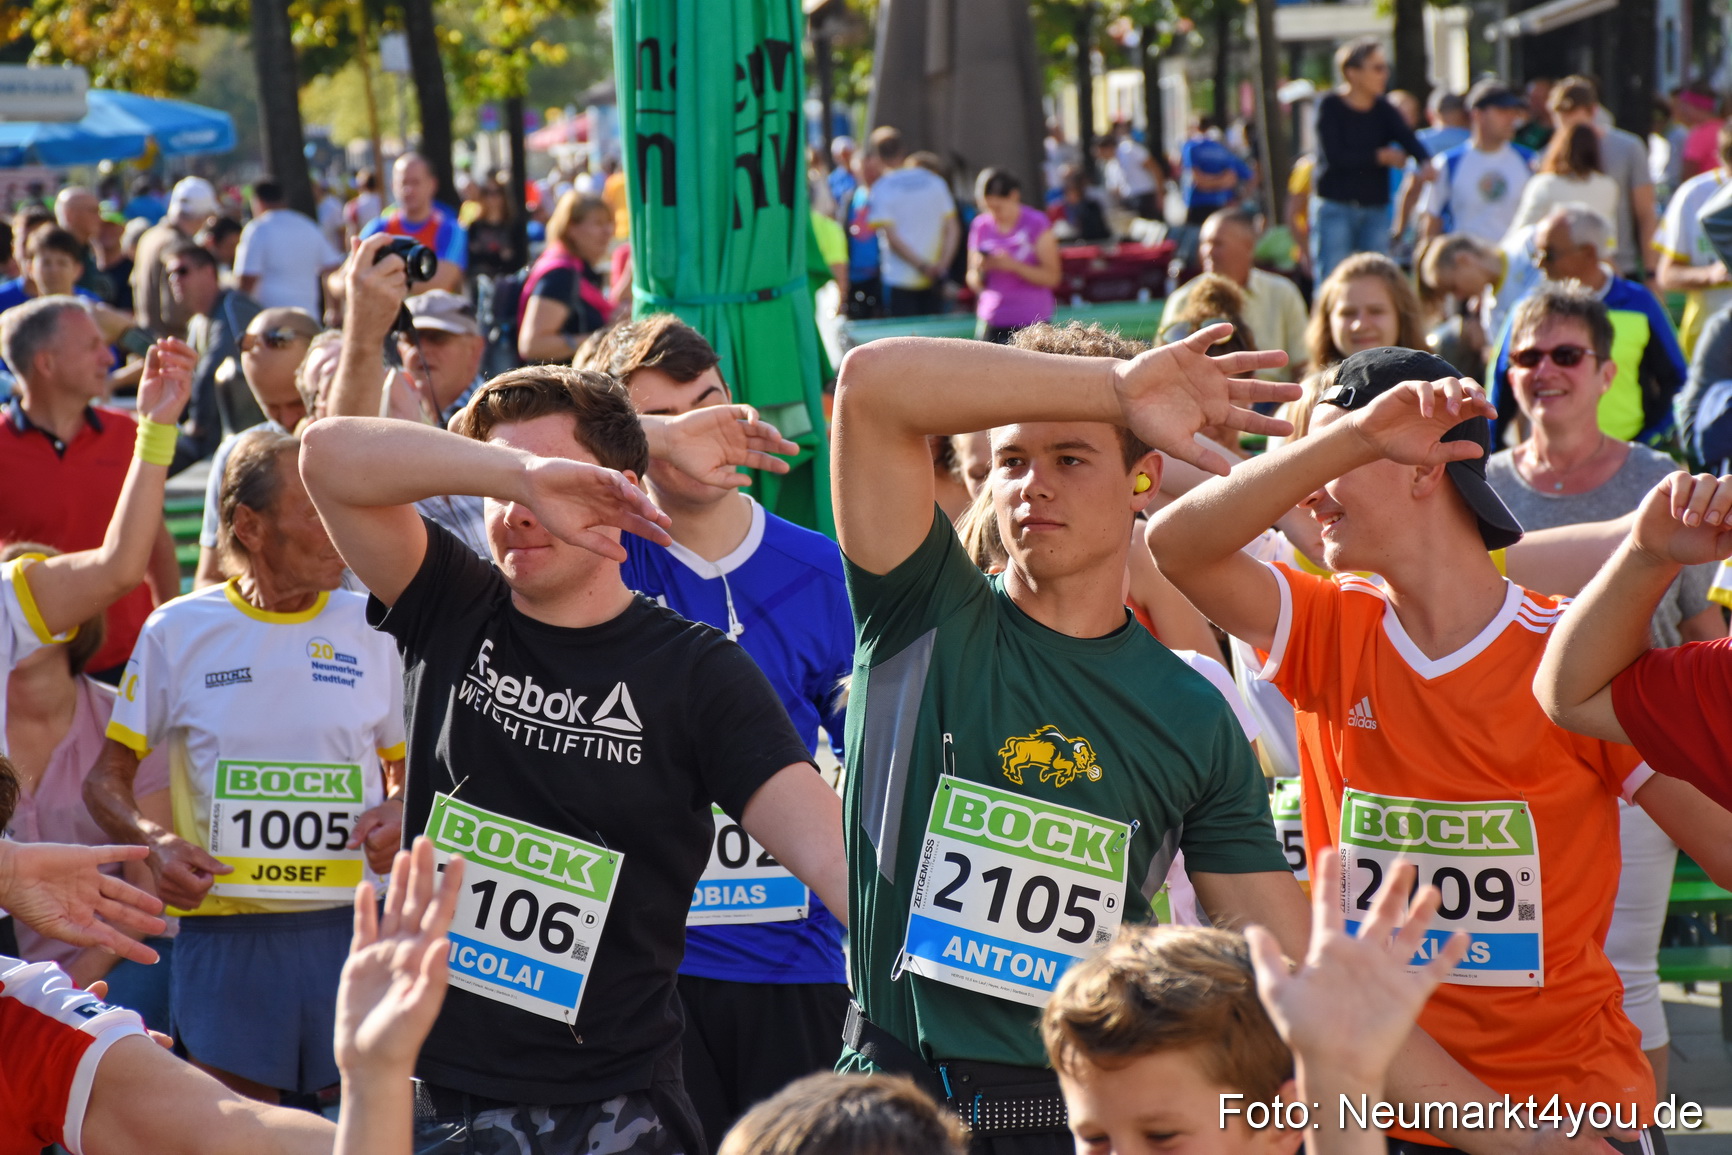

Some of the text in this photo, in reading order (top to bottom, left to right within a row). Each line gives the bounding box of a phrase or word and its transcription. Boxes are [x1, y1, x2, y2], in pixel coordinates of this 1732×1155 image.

[310, 643, 333, 660] 20
[205, 667, 251, 685] BOCK
[311, 661, 364, 678] Neumarkter
[312, 672, 356, 689] Stadtlauf
[1348, 715, 1377, 730] adidas
[227, 767, 351, 796] BOCK
[231, 809, 350, 851] 1005
[945, 790, 1111, 870] BOCK
[1352, 801, 1514, 847] BOCK
[438, 808, 598, 889] BOCK
[250, 865, 327, 882] JOSEF
[440, 865, 581, 954] 106
[691, 885, 767, 907] OBIAS
[933, 851, 1101, 944] 2105
[448, 941, 545, 991] ICOLAI
[941, 935, 1057, 985] ANTON
